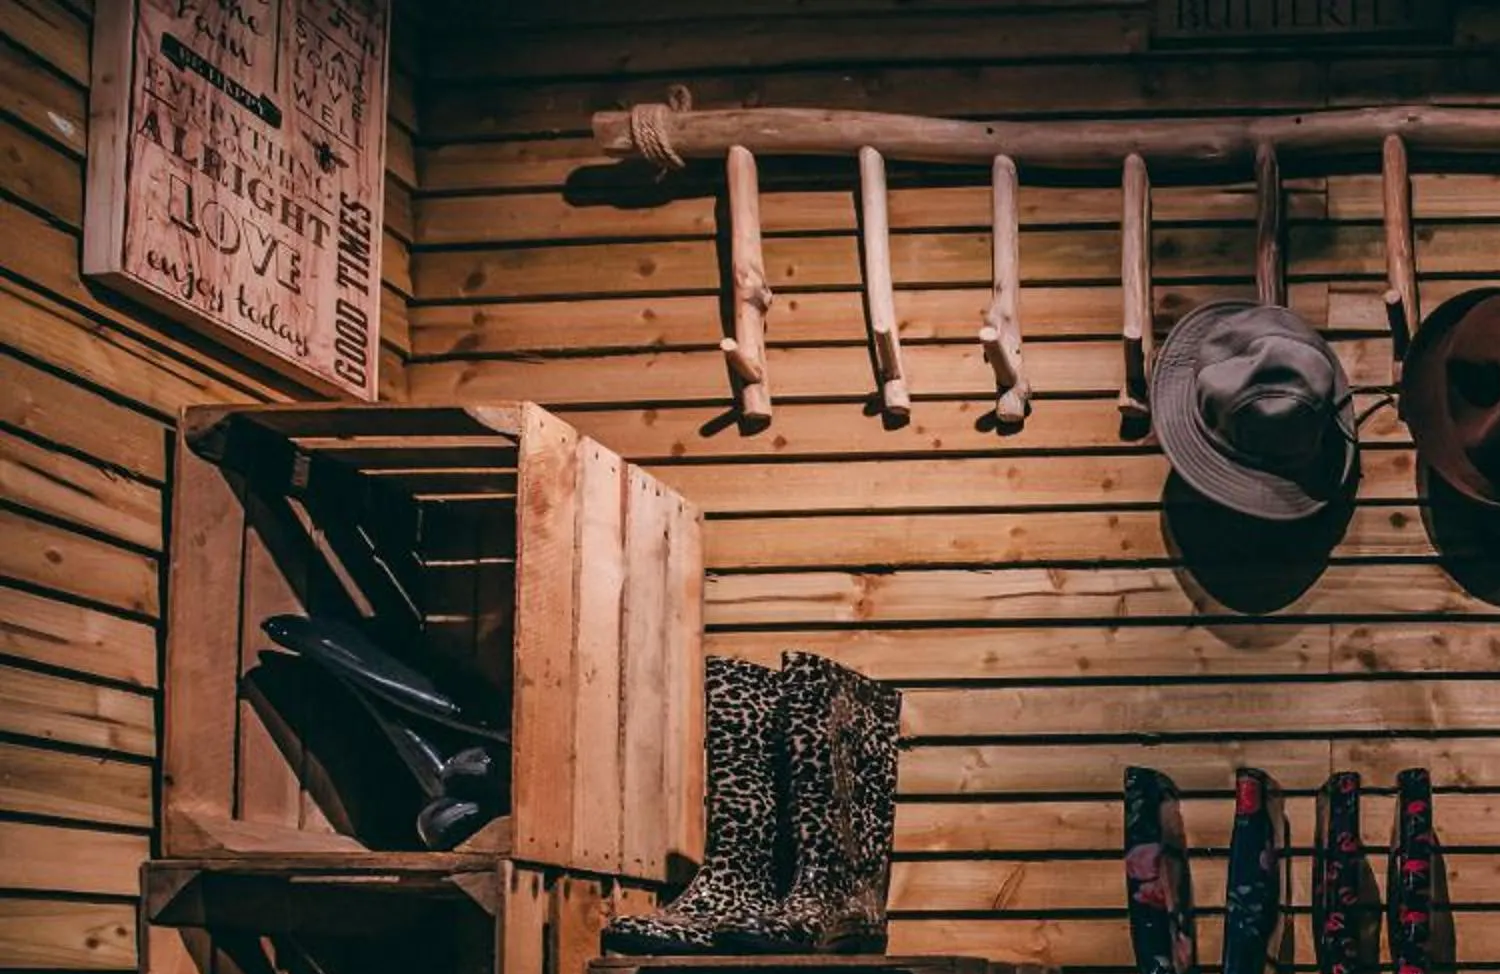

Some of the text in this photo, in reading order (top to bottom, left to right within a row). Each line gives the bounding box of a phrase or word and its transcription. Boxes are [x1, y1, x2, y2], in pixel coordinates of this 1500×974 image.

[236, 284, 309, 357] today
[334, 191, 372, 388] GOOD TIMES
